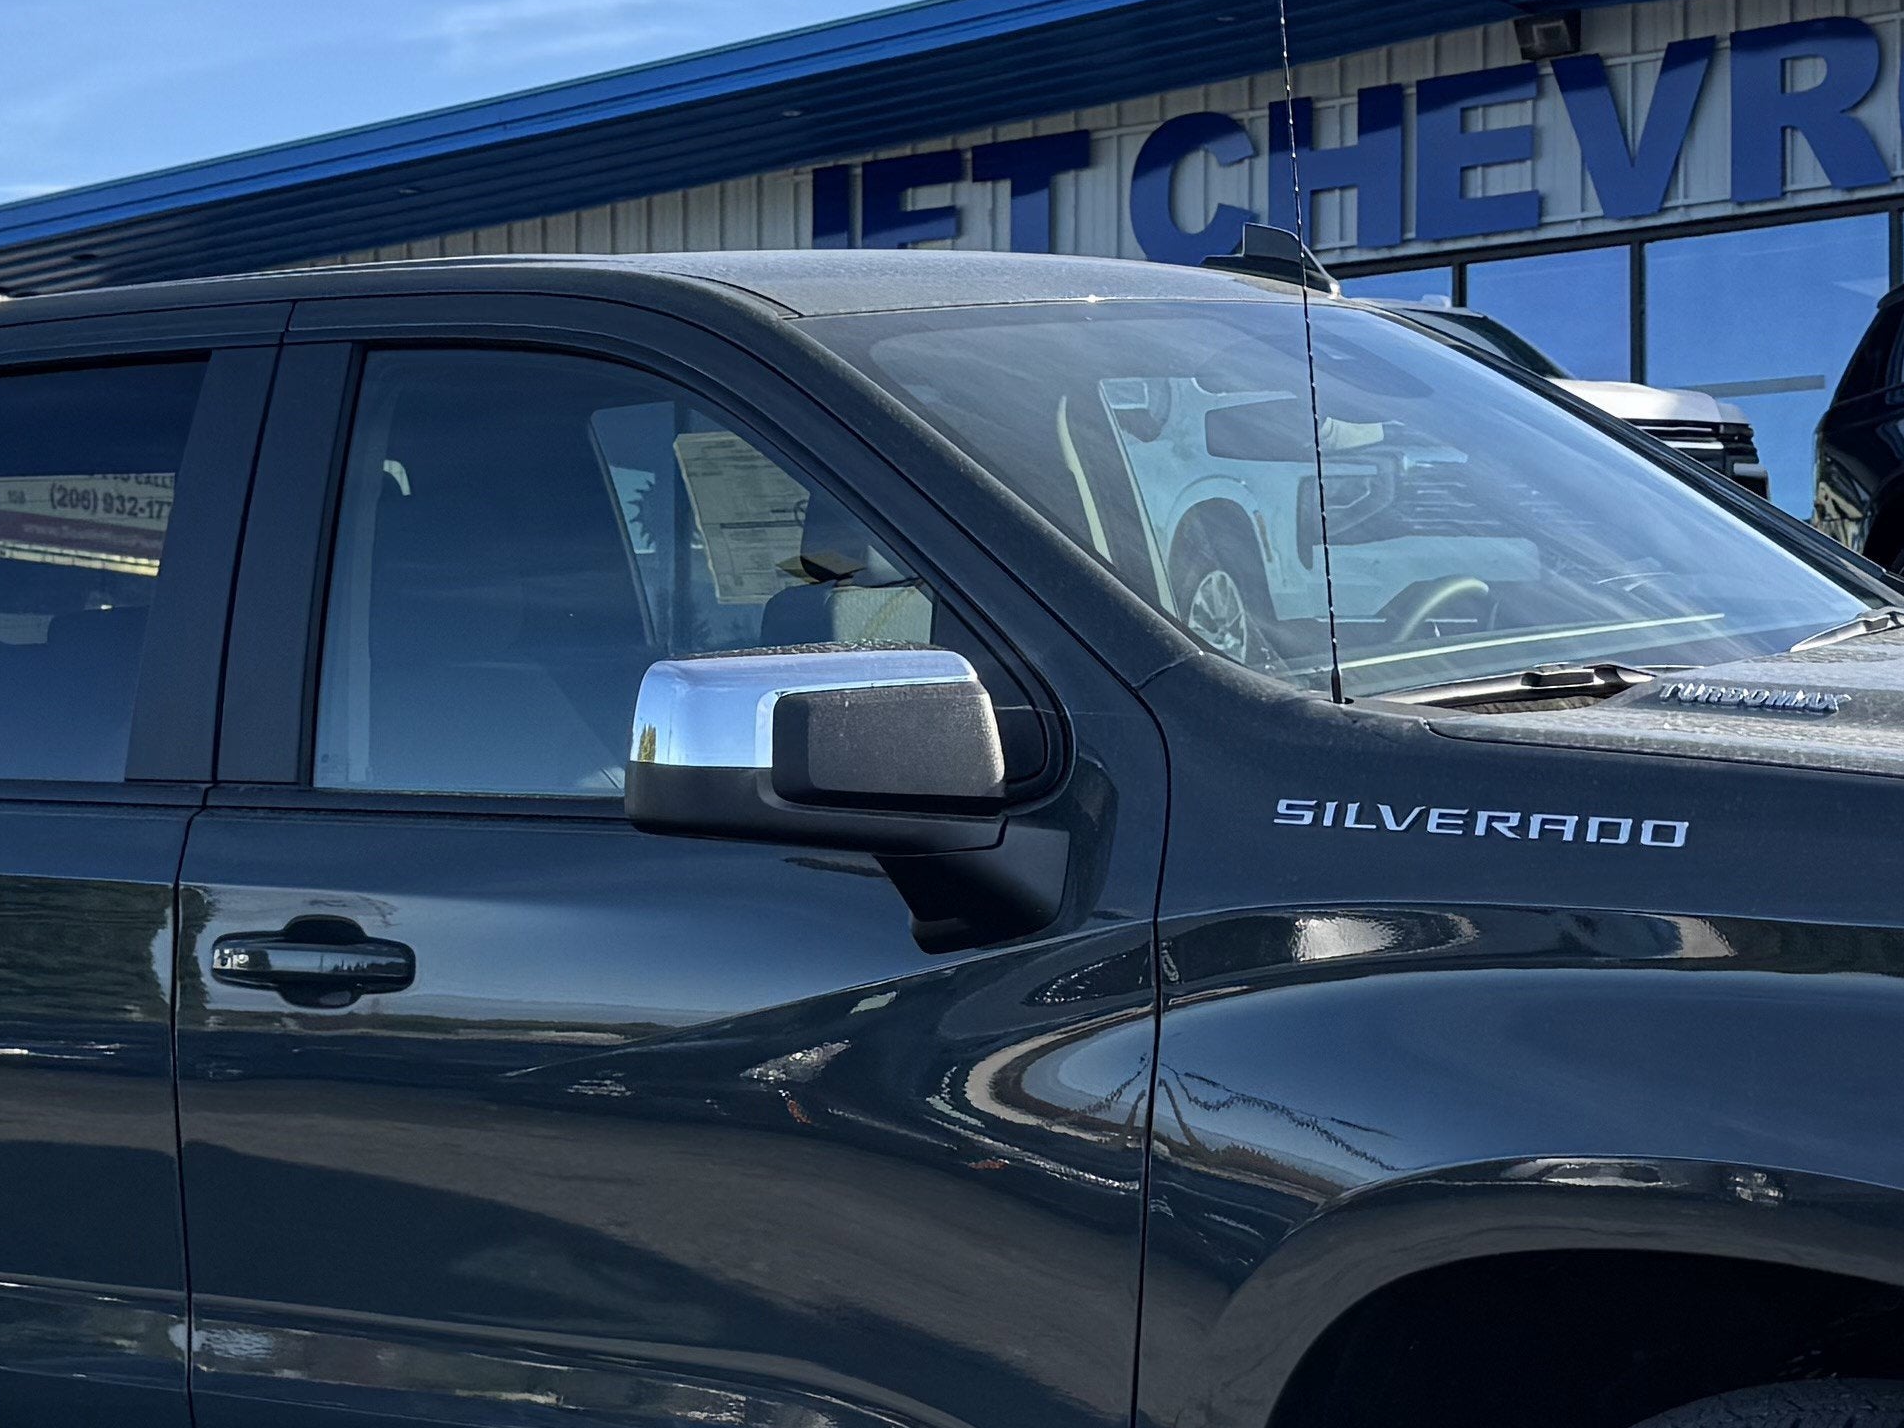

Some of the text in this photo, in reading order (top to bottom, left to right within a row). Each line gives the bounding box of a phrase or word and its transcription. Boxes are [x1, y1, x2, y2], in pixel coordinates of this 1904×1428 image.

[50, 482, 98, 515] (206)
[1659, 682, 1852, 713] TURBOMAX
[1273, 798, 1690, 848] SILVERADO
